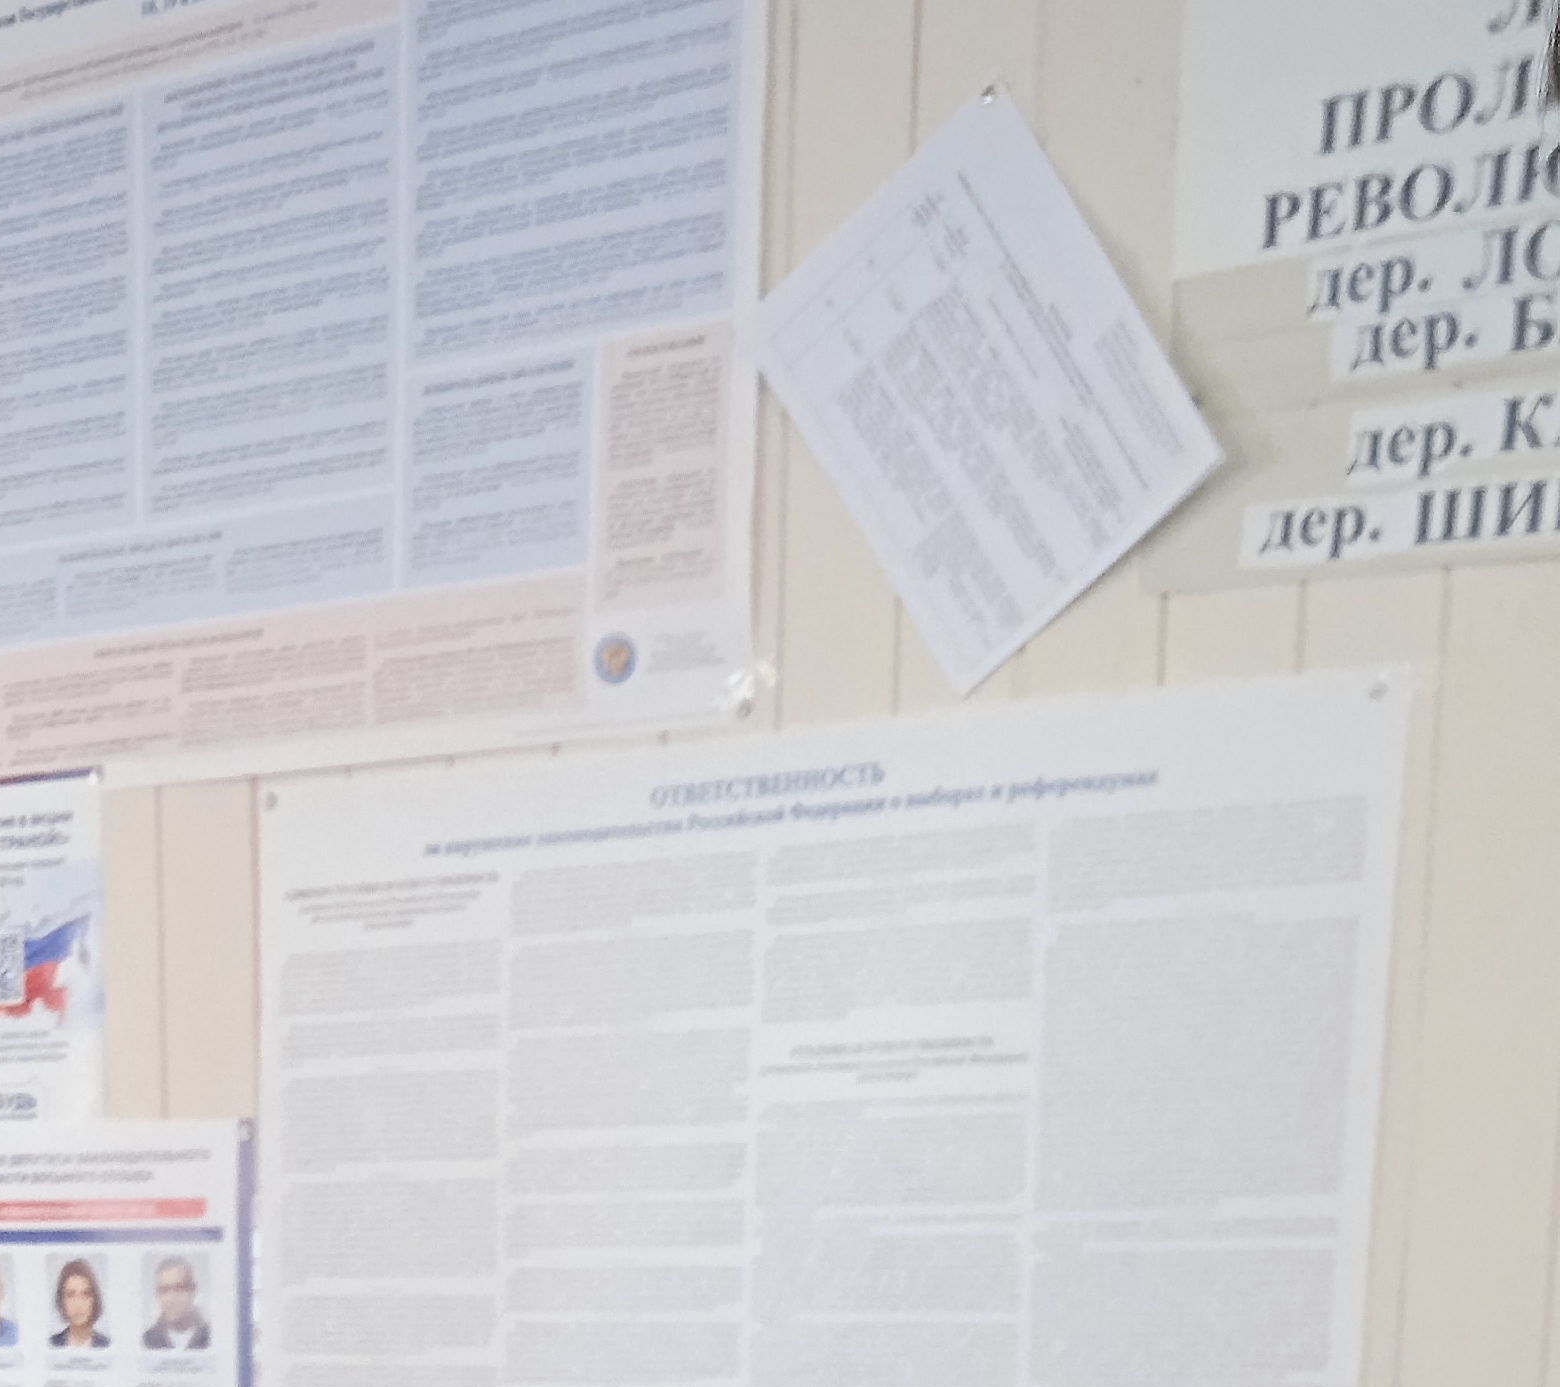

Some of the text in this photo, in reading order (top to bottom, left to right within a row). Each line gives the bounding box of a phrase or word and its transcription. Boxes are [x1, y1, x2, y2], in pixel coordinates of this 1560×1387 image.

[1306, 254, 1432, 315] дер.
[1349, 311, 1479, 371] дер.
[1346, 393, 1560, 479] дер. К
[1258, 479, 1560, 560] дер. ШИ
[649, 761, 886, 810] ОТВЕТСТВЕННОСТЬ
